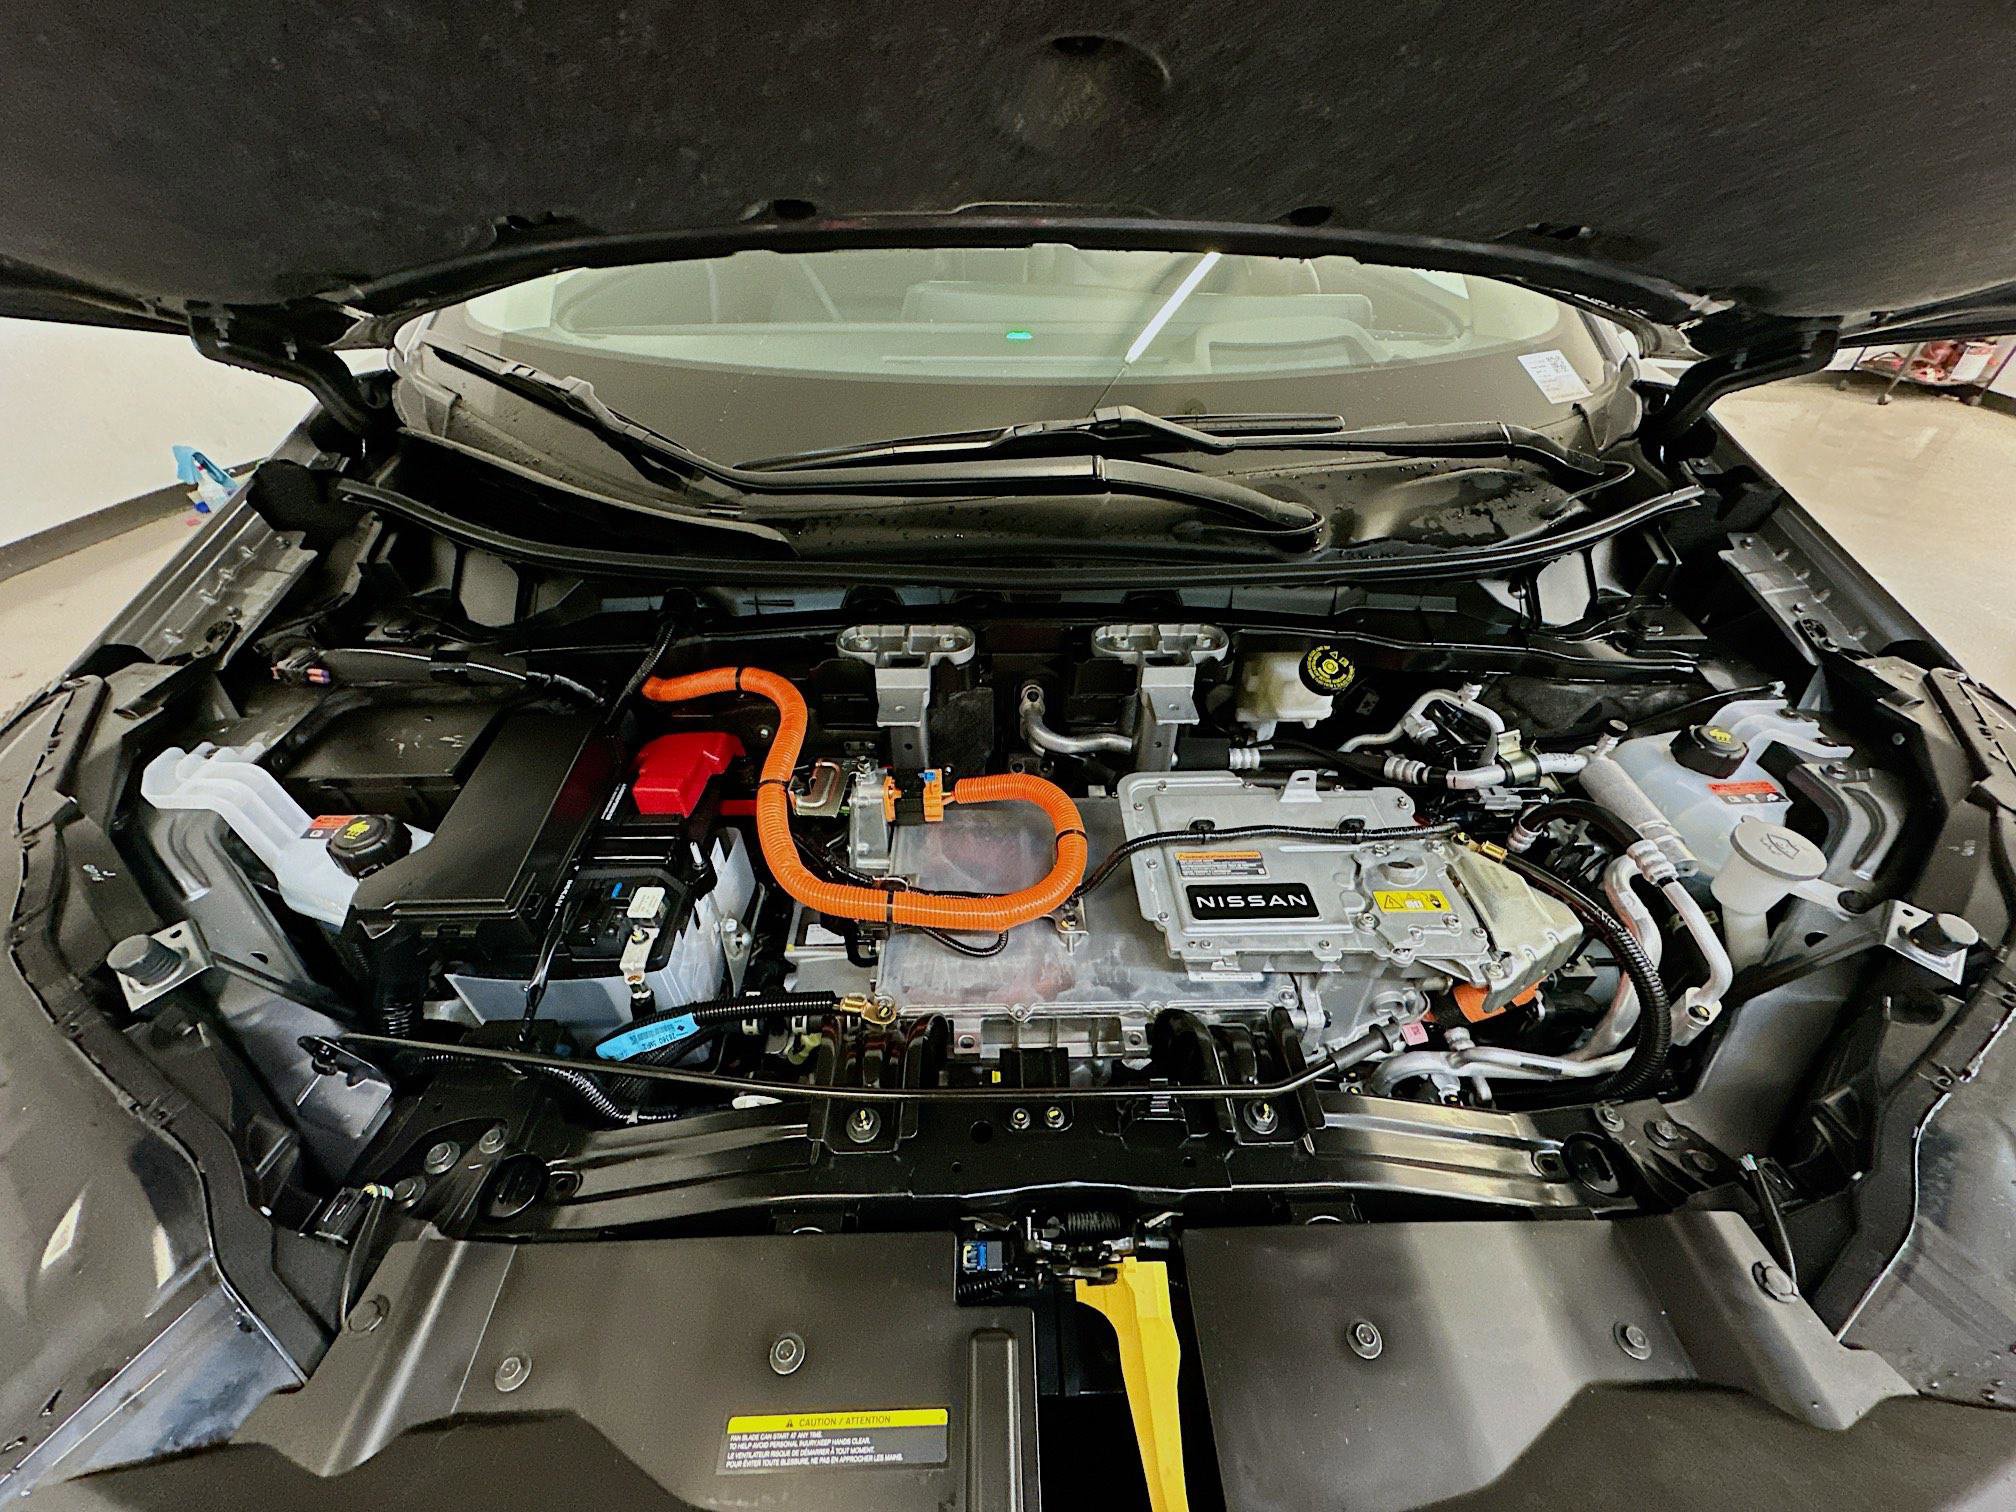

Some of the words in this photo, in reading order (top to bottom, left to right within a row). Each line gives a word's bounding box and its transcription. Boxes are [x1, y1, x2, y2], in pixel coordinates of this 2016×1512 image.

[1196, 894, 1308, 908] NISSAN
[799, 1417, 836, 1426] CAUTION
[846, 1415, 891, 1425] ATTENTION
[770, 1440, 798, 1448] PERSONAL
[839, 1455, 873, 1463] APPROCHER
